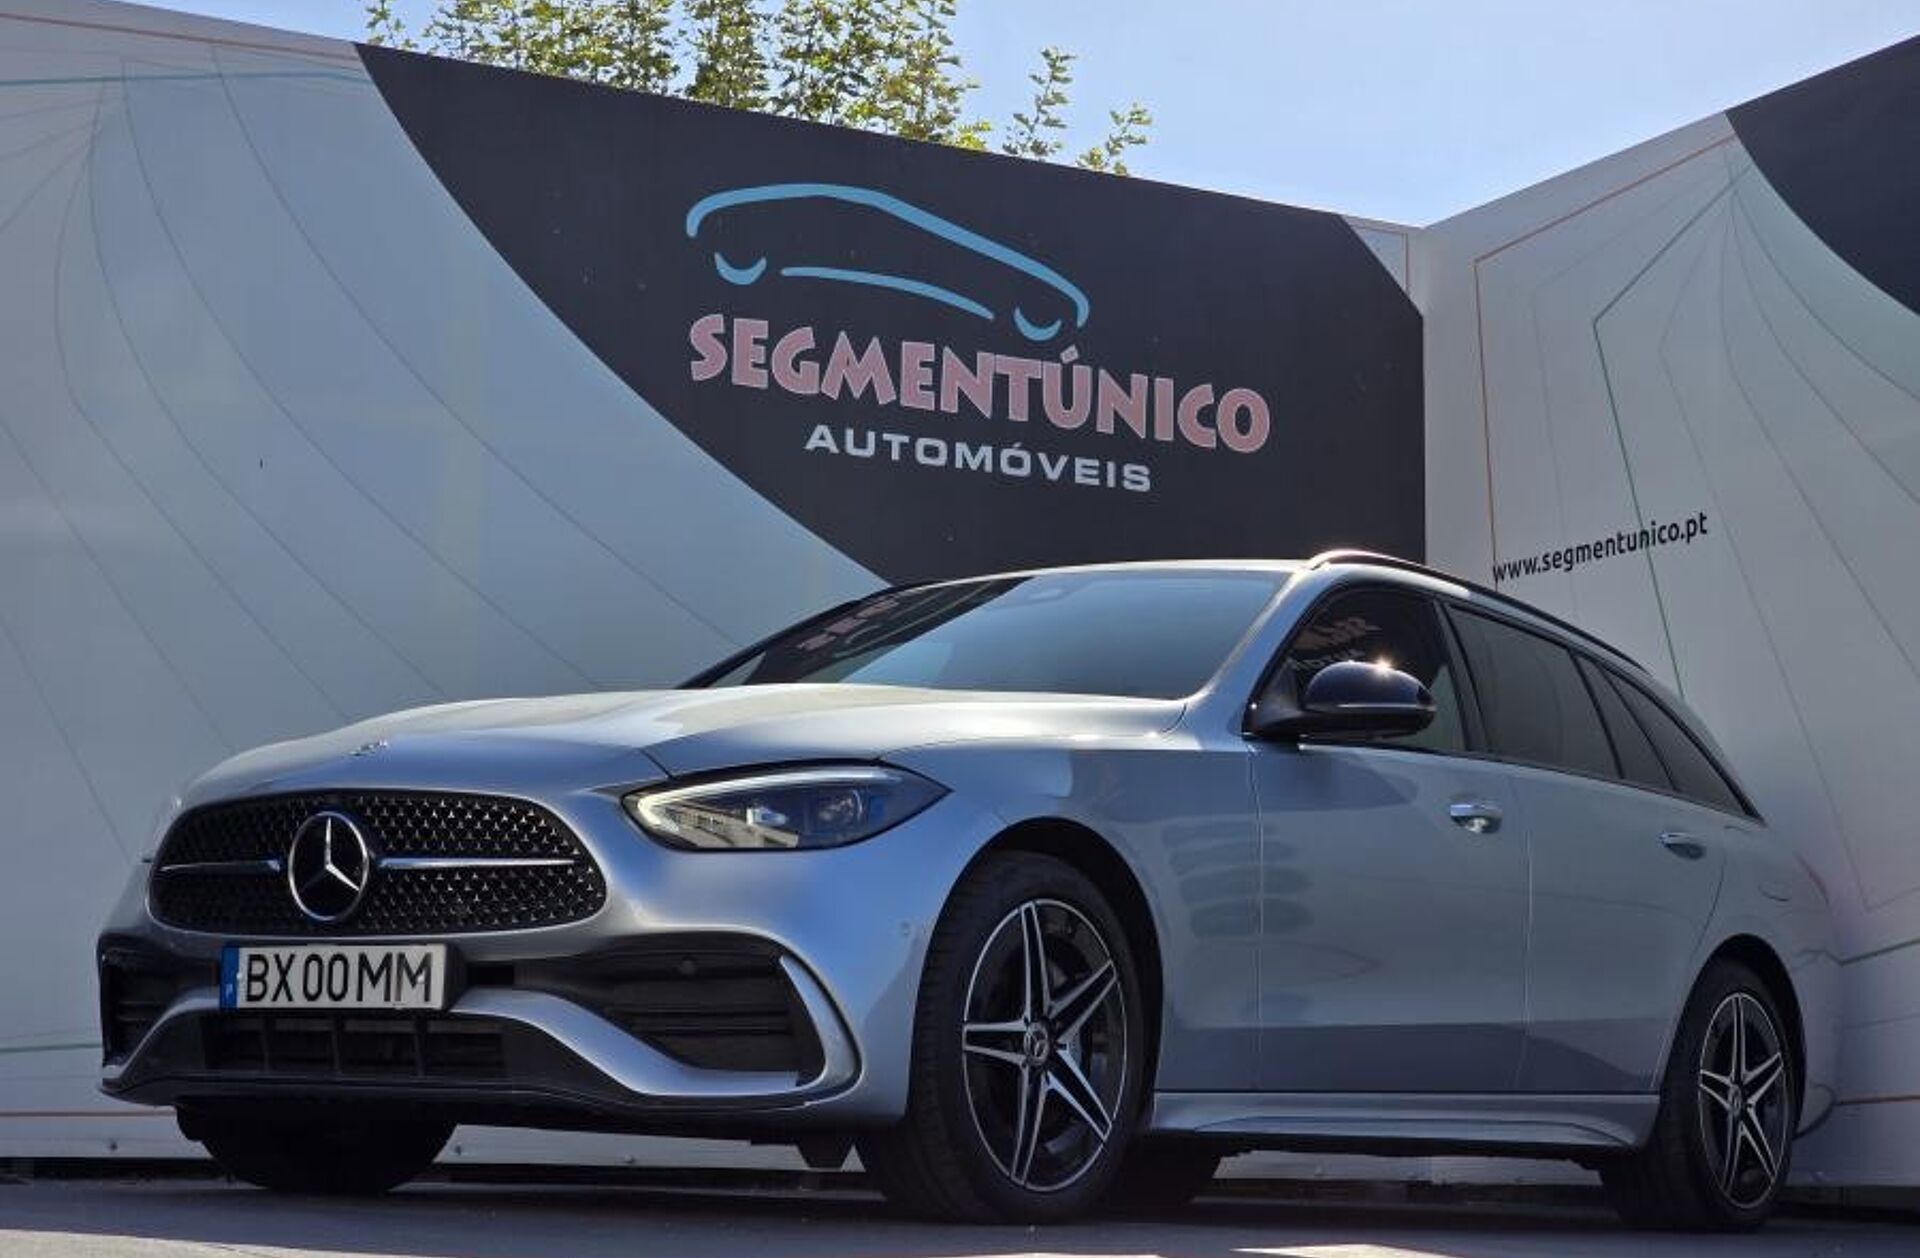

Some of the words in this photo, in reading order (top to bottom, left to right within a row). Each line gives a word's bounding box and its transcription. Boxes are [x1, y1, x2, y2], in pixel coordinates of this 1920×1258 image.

[689, 313, 1271, 453] SEGMENTÚNICO
[804, 424, 1152, 492] AUTOMÓVEIS
[1492, 512, 1708, 583] www.segmentunico.pt
